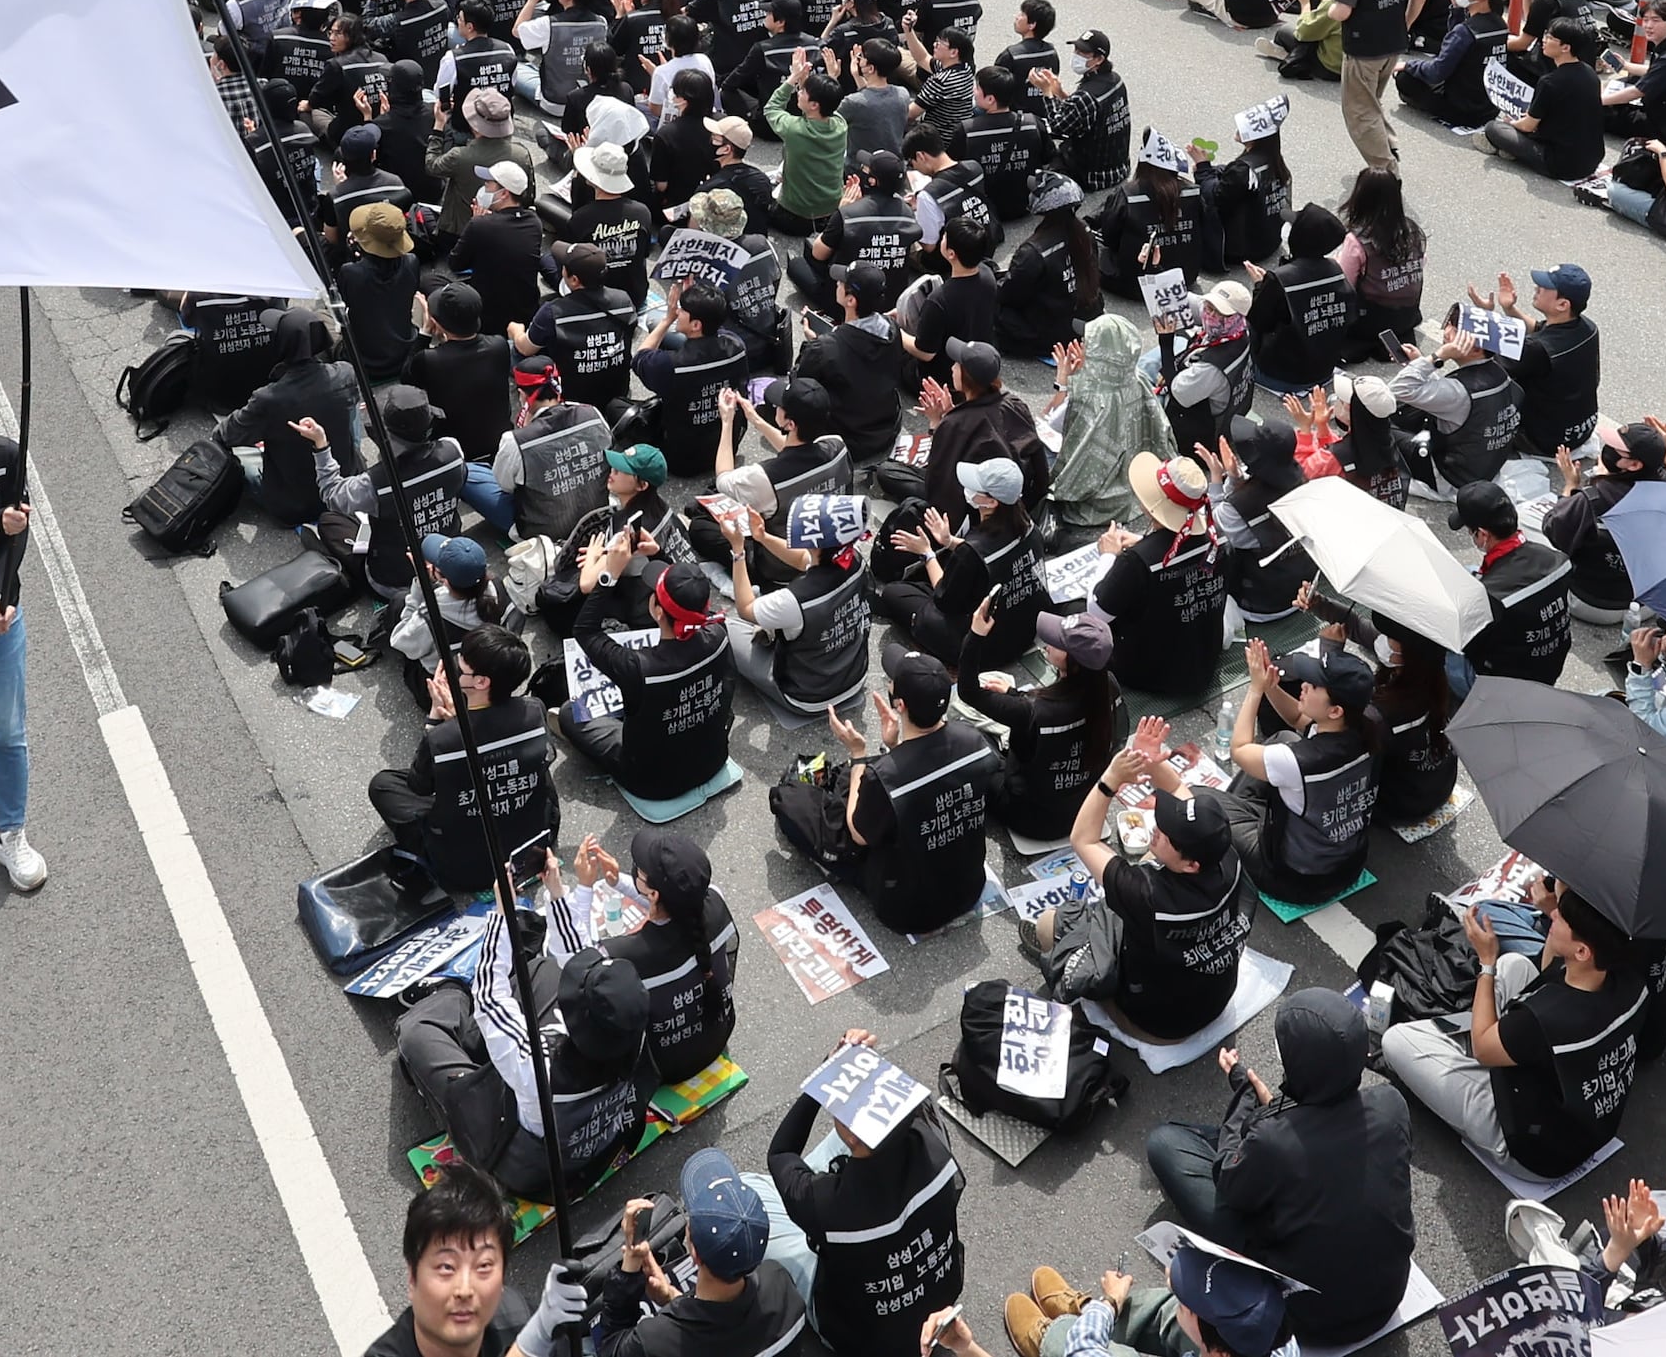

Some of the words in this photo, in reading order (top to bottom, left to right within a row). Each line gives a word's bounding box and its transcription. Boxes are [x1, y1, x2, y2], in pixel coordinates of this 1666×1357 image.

[1487, 68, 1527, 97] 상한폐지
[591, 218, 641, 241] Alaska
[668, 235, 737, 262] 상한폐지
[660, 258, 730, 289] 실현하자
[224, 308, 258, 325] 삼성그룹
[213, 325, 238, 341] 초기업
[218, 338, 251, 354] 삼성전자
[254, 335, 271, 347] 지부
[586, 331, 616, 345] 삼성그룹
[573, 348, 598, 360] 초기업
[577, 358, 609, 374] 삼성전자
[555, 441, 589, 464] 삼성그룹
[544, 464, 570, 483] 초기업
[572, 451, 604, 474] 노동조합
[551, 475, 586, 497] 삼성전자
[587, 466, 603, 482] 지부
[412, 487, 445, 510] 삼성그룹
[679, 674, 713, 701] 삼성그룹
[662, 703, 691, 722] 초기업
[667, 713, 705, 735] 삼성전자
[496, 772, 538, 796] 노동조합
[935, 783, 974, 812] 삼성그룹
[920, 815, 950, 836] 초기업
[953, 800, 985, 822] 노동조
[926, 823, 966, 851] 삼성전자
[796, 895, 878, 969] 투명하게
[770, 920, 846, 994] 바꾸고!!!
[652, 1014, 686, 1033] 초기업
[1581, 1074, 1616, 1102] 초기업
[886, 1227, 935, 1270] 삼성그룹
[864, 1274, 905, 1295] 초기업
[874, 1284, 925, 1316] 삼성전자
[1449, 1270, 1586, 1348] 실현하자
